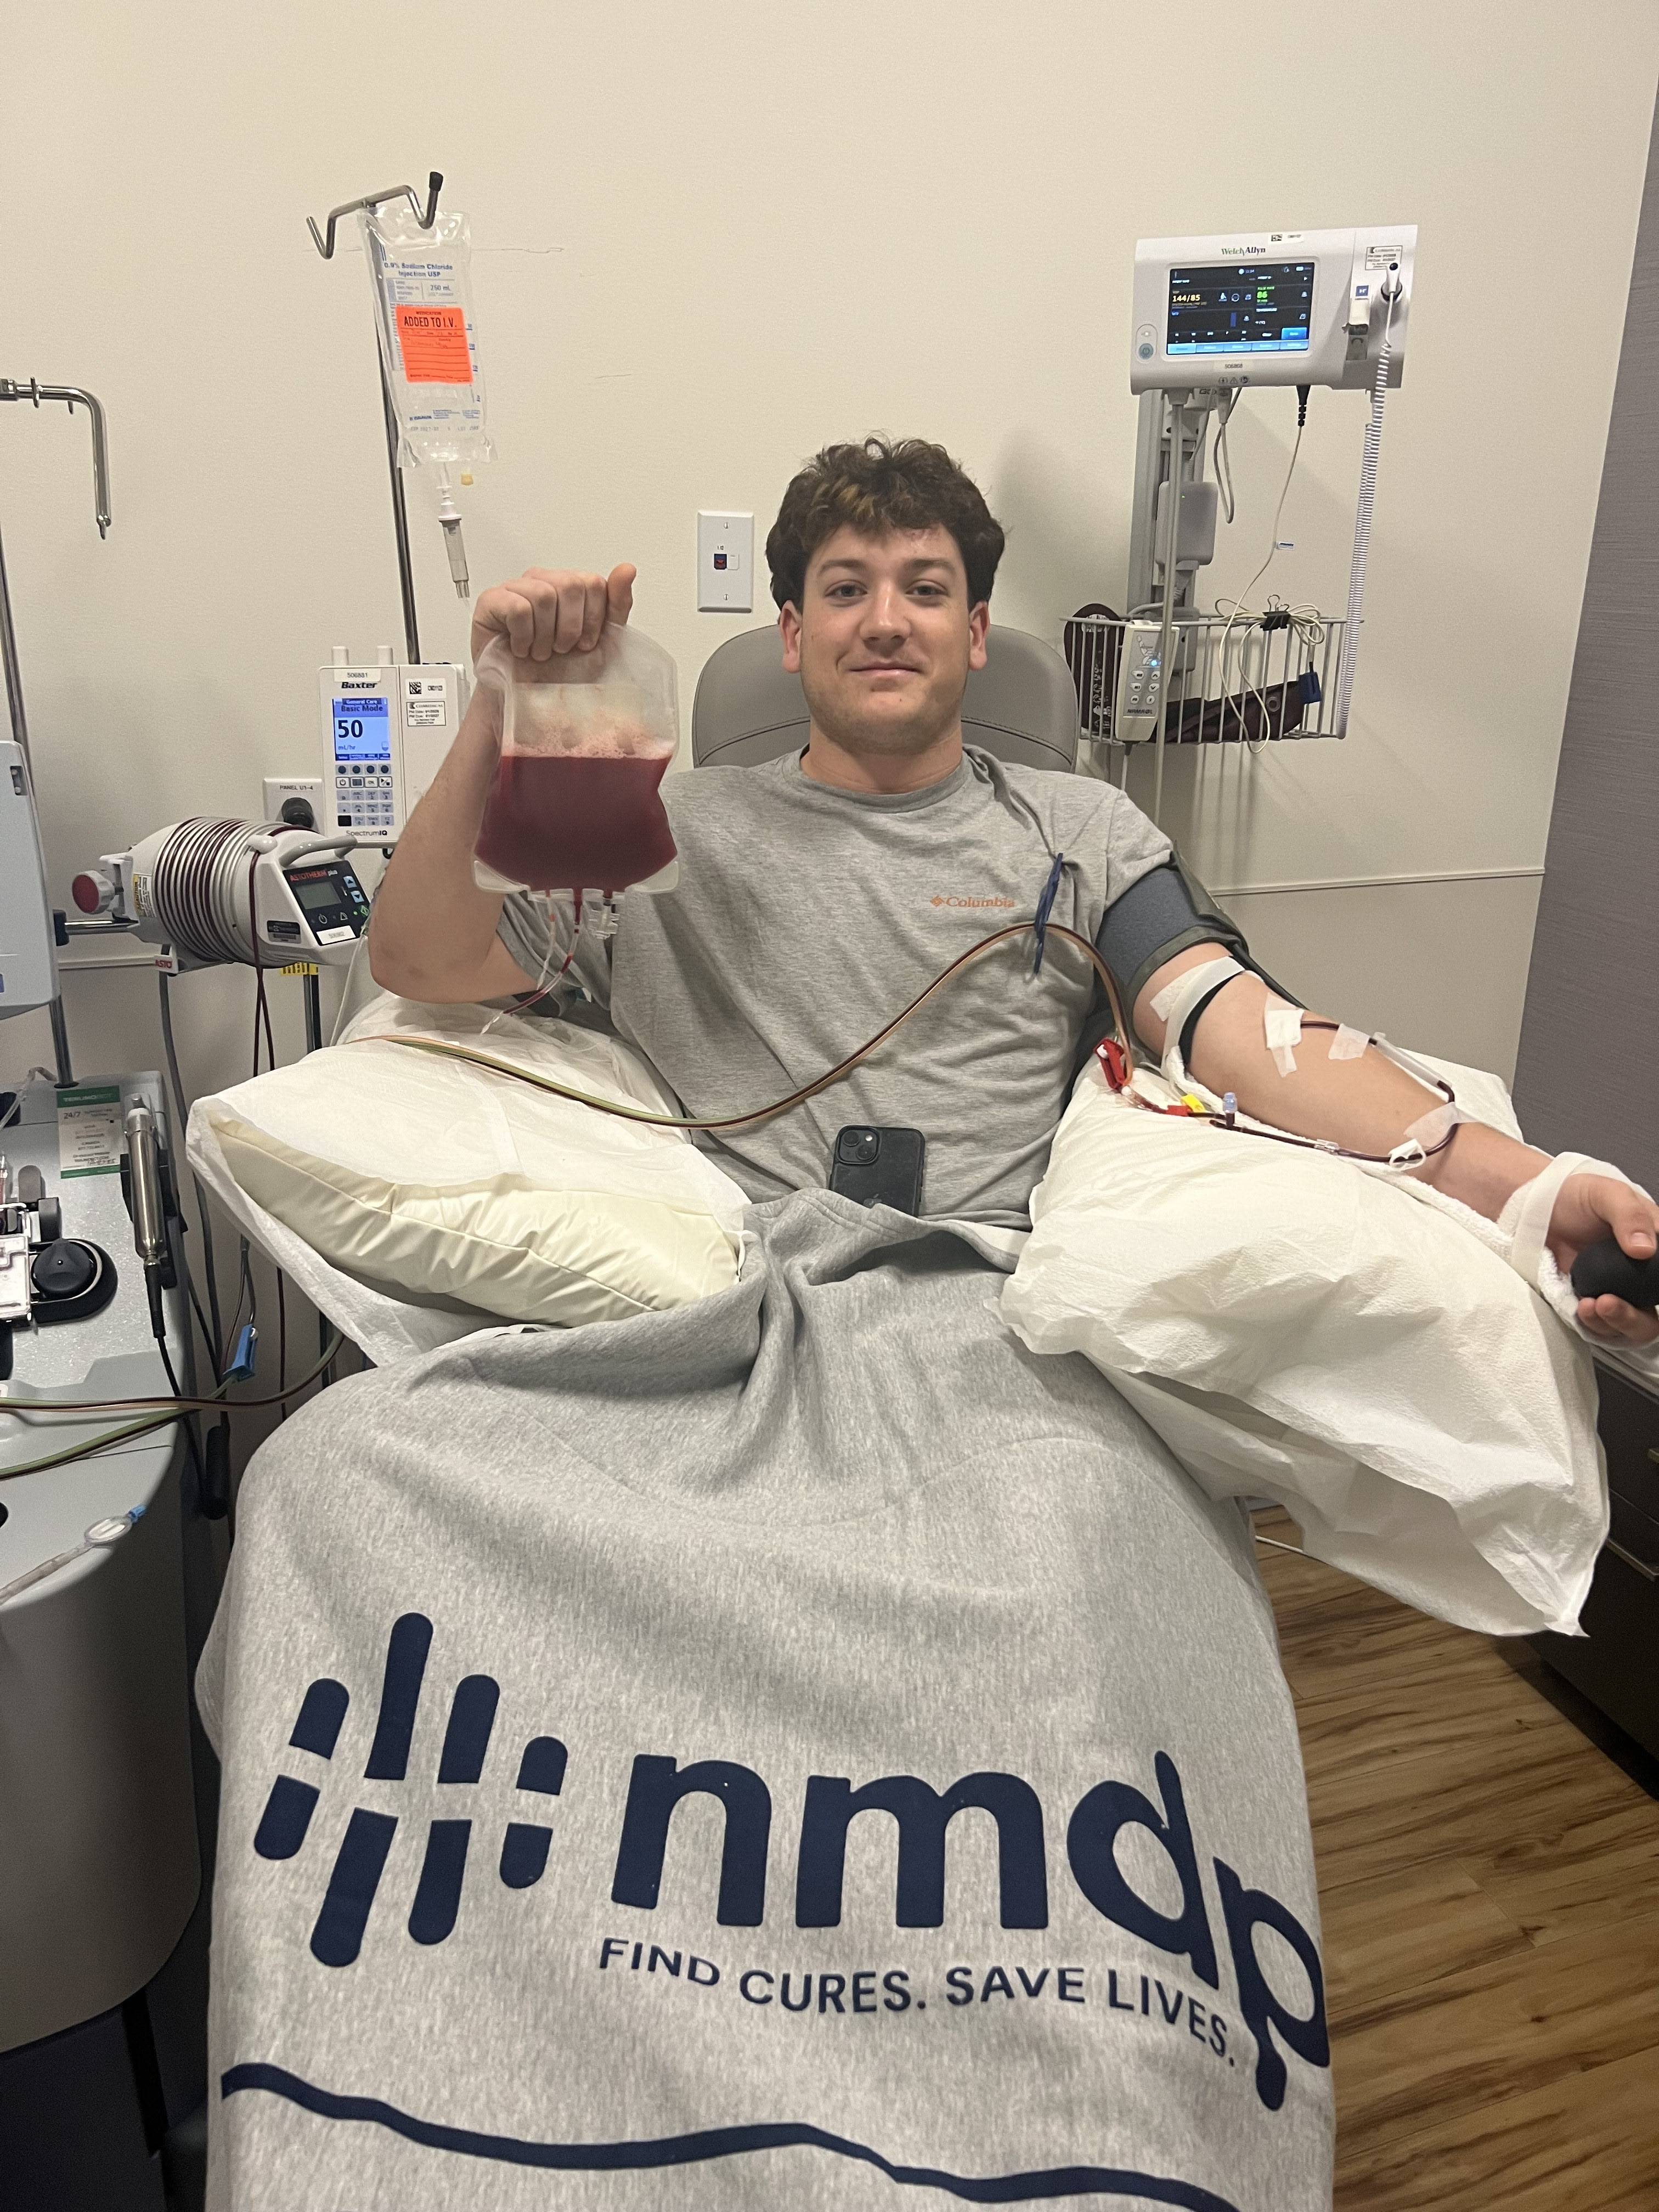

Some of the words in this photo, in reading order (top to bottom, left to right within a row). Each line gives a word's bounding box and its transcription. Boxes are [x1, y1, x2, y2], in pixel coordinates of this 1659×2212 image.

[1172, 294, 1200, 302] 144/85
[404, 316, 429, 327] ADDED
[431, 317, 441, 328] TO
[443, 317, 457, 328] I.V.
[338, 719, 363, 738] 50
[946, 896, 1015, 908] Columbia
[63, 1111, 81, 1119] 24/7
[611, 1750, 1331, 2111] nmdp
[598, 1937, 722, 1987] FIND
[739, 1968, 927, 2015] CURES.
[945, 1966, 1086, 2006] SAVE
[1106, 1968, 1235, 2068] LIVES.
